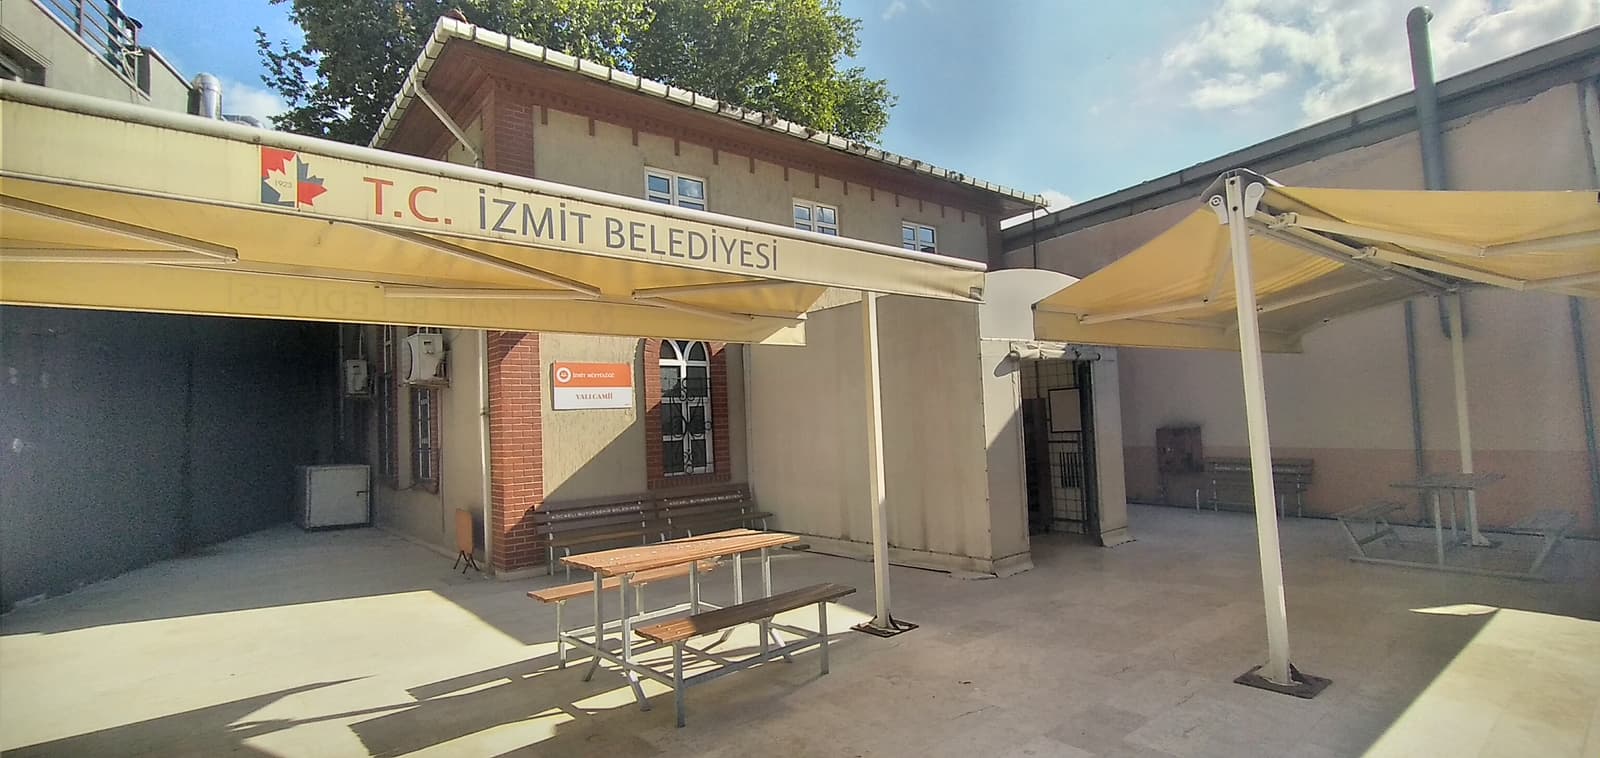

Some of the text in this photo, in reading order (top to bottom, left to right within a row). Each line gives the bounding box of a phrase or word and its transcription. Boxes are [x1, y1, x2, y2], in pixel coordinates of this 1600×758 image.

[275, 179, 293, 189] 1923
[363, 177, 777, 271] T.C. İZMİT BELEDİYESİ
